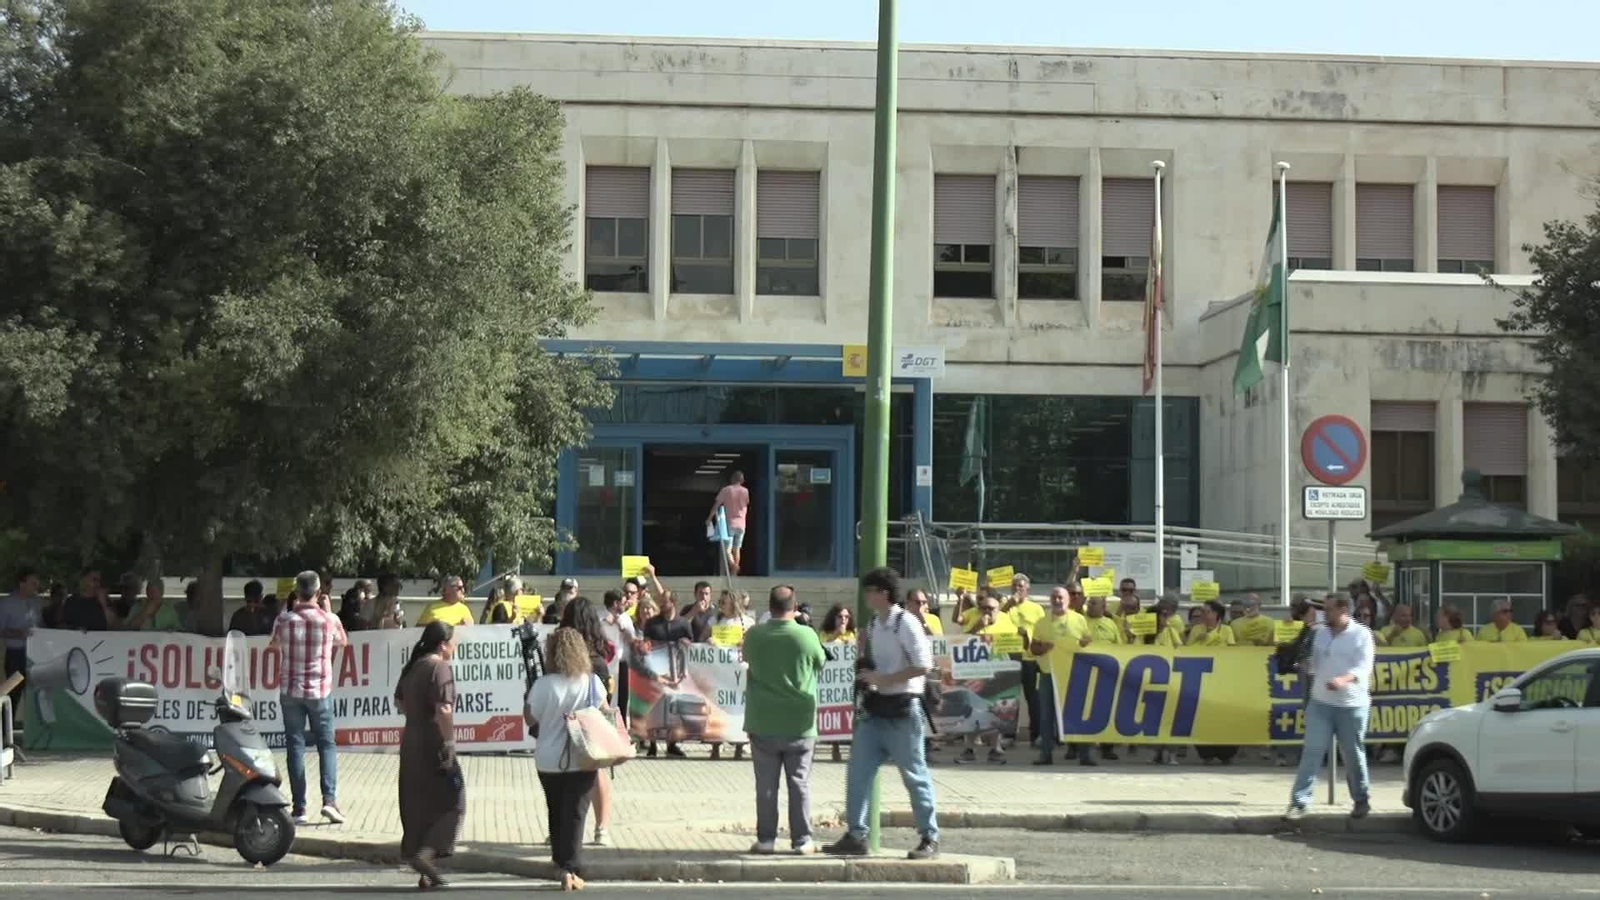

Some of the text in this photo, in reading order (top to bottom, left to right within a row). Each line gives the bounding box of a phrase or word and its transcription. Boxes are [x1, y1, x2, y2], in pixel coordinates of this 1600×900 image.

[915, 357, 937, 366] DGT
[719, 649, 733, 664] DE
[497, 663, 513, 680] NO
[718, 690, 737, 706] SIN
[1062, 652, 1214, 738] DGT
[186, 701, 204, 720] DE
[353, 697, 391, 716] PARA
[349, 729, 400, 744] LA DGT NOS
